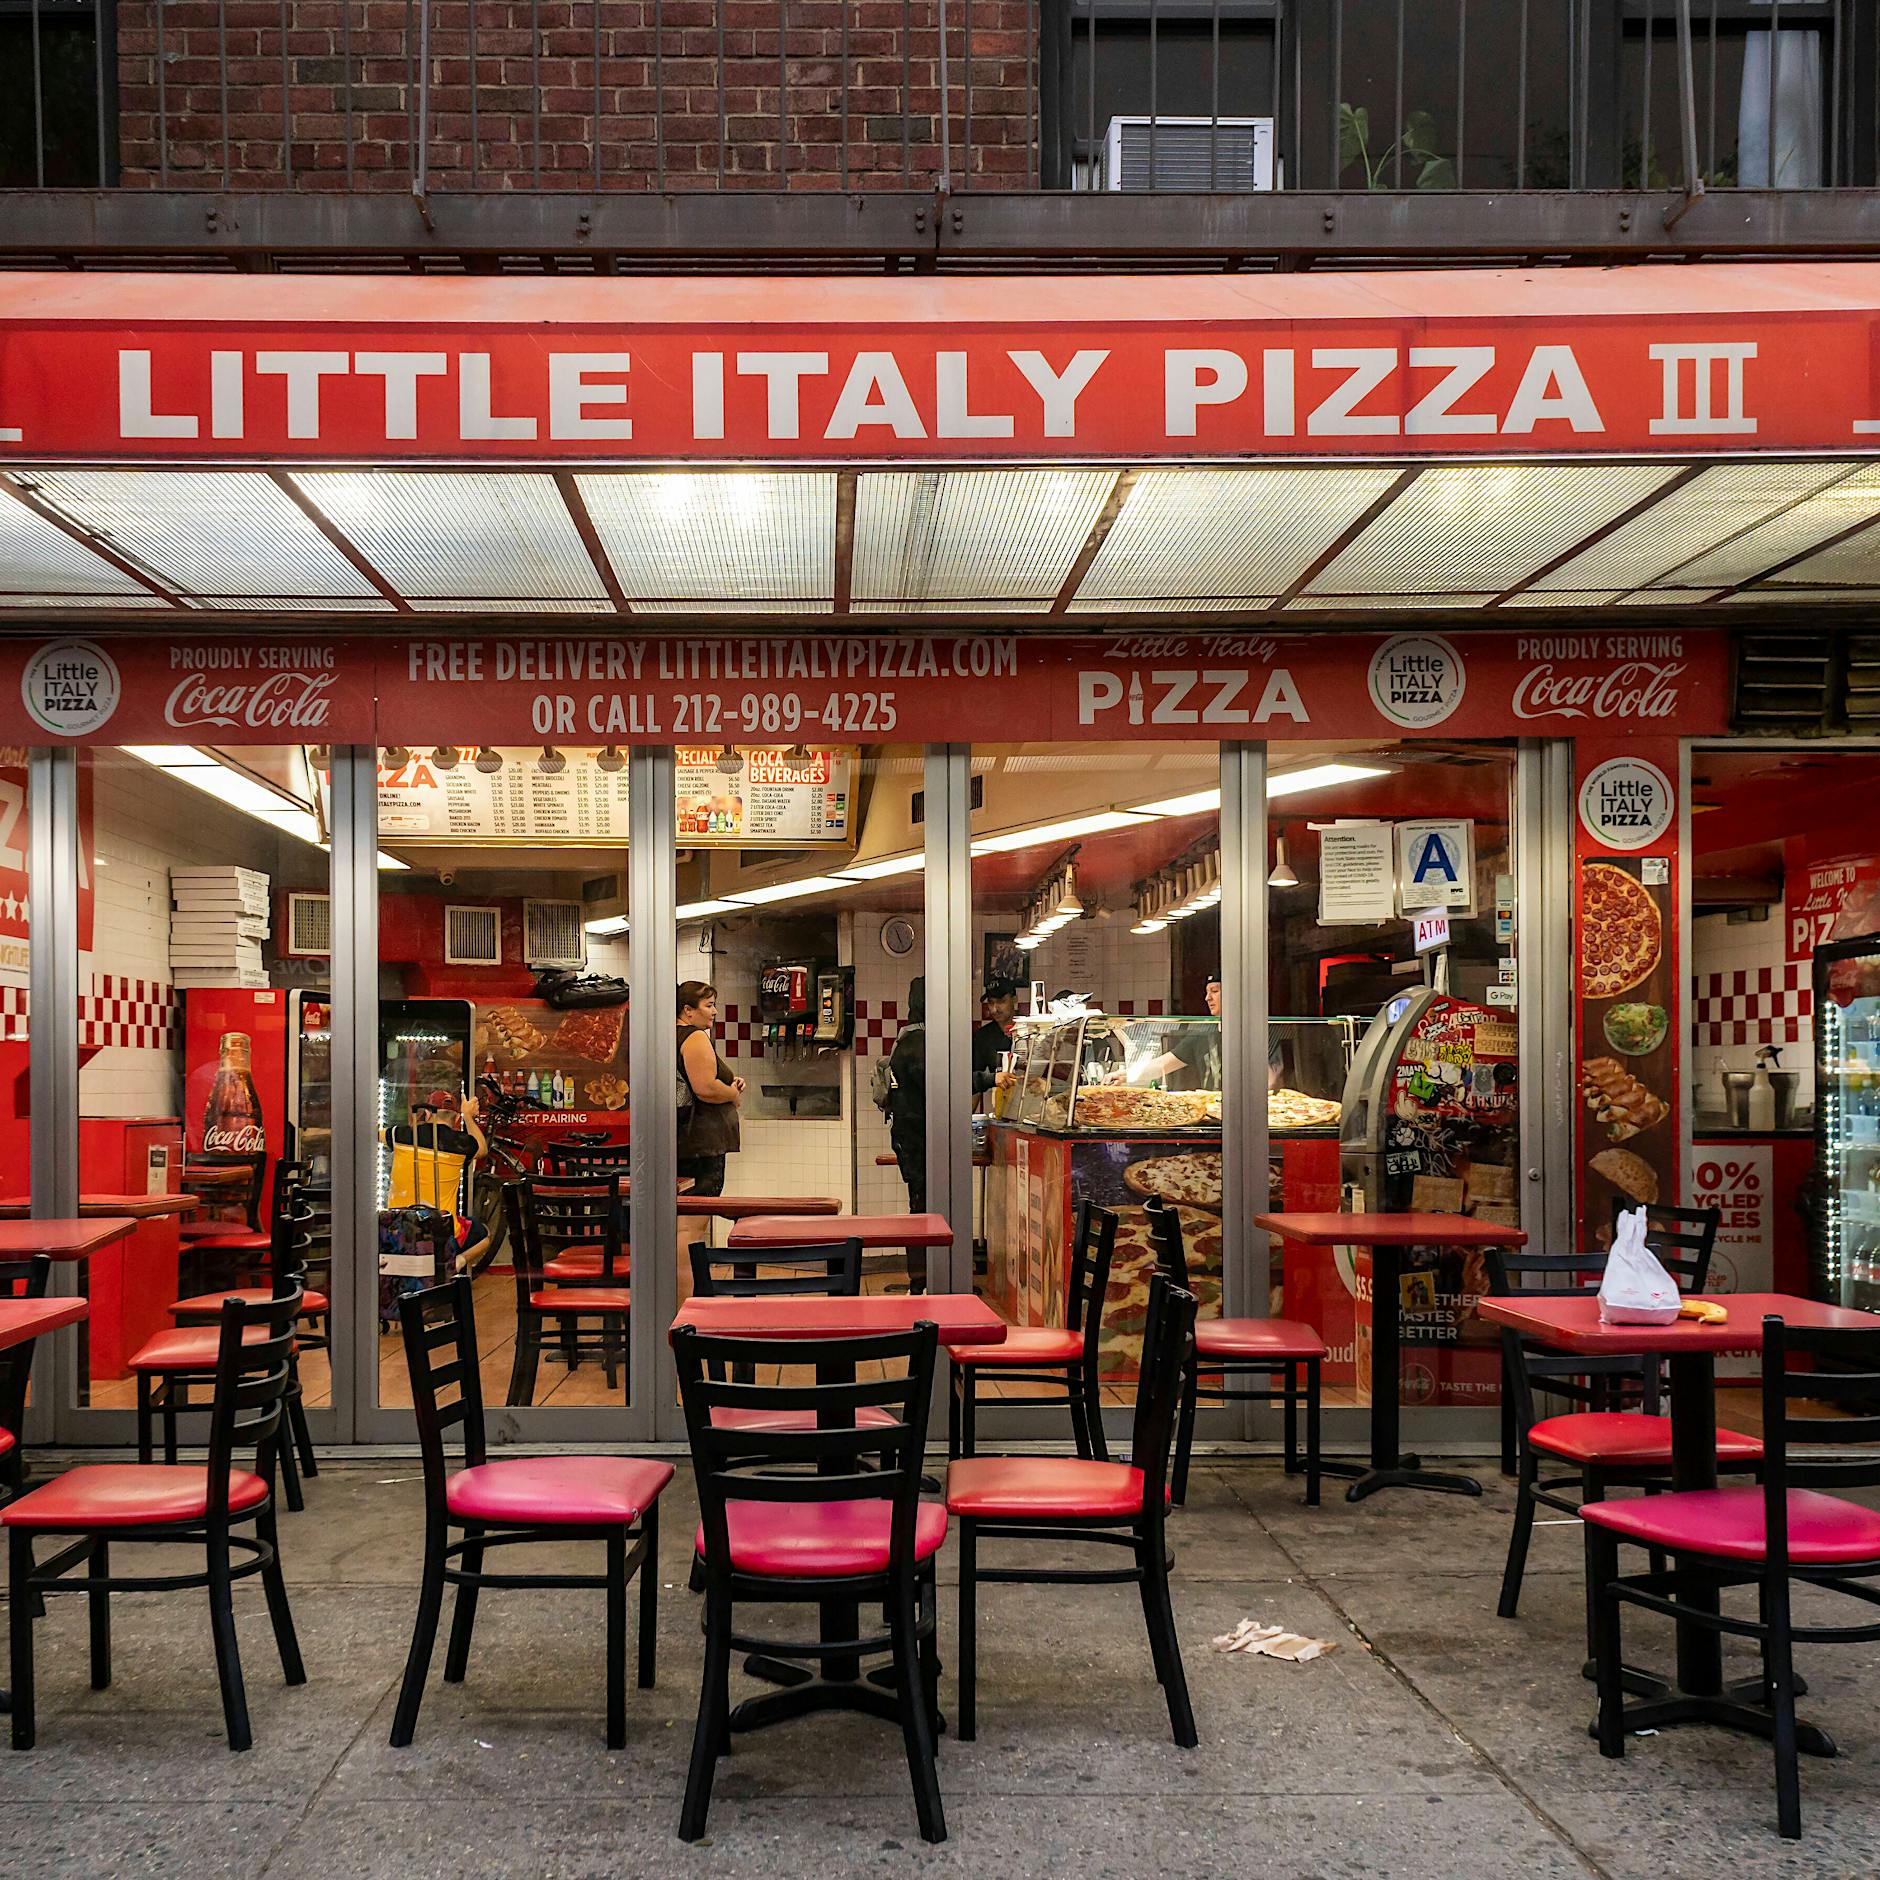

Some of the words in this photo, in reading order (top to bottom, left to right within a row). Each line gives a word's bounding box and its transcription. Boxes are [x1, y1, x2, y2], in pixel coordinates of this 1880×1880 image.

[119, 350, 632, 440] LITTLE
[692, 350, 1111, 439] ITALY
[1164, 345, 1606, 437] PIZZA
[1649, 342, 1757, 435] III
[170, 647, 255, 669] PROUDLY
[258, 646, 335, 669] SERVING
[1103, 636, 1190, 658] Little
[1203, 635, 1278, 663] Italy
[1517, 638, 1601, 660] PROUDLY
[1606, 636, 1683, 658] SERVING
[407, 641, 484, 681] FREE
[496, 640, 644, 680] DELIVERY
[659, 638, 1018, 678] LITTLEITALYPIZZA.COM
[1390, 655, 1444, 673] Little
[45, 663, 98, 680] Little
[1390, 673, 1444, 689] ITALY
[45, 682, 98, 696] ITALY
[164, 671, 339, 728] Coca-Cola
[1078, 669, 1311, 724] PIZZA
[1390, 691, 1444, 704] PIZZA
[1512, 662, 1688, 719] Coca-Cola
[45, 698, 98, 711] PIZZA
[532, 694, 576, 734] OR
[588, 694, 661, 733] CALL
[673, 691, 897, 732] 212-989-4225
[751, 767, 826, 783] BEVERAGES
[1601, 780, 1653, 797] Little
[1601, 798, 1653, 813] ITALY
[1601, 814, 1653, 826] PIZZA
[1413, 834, 1457, 883] A
[1810, 868, 1844, 890] WELCOME
[1845, 866, 1856, 883] TO
[1419, 920, 1446, 942] ATM
[542, 1114, 587, 1123] PAIRING
[203, 1125, 265, 1152] Coca-Cola
[1440, 1381, 1472, 1392] TASTE
[1477, 1383, 1496, 1393] THE
